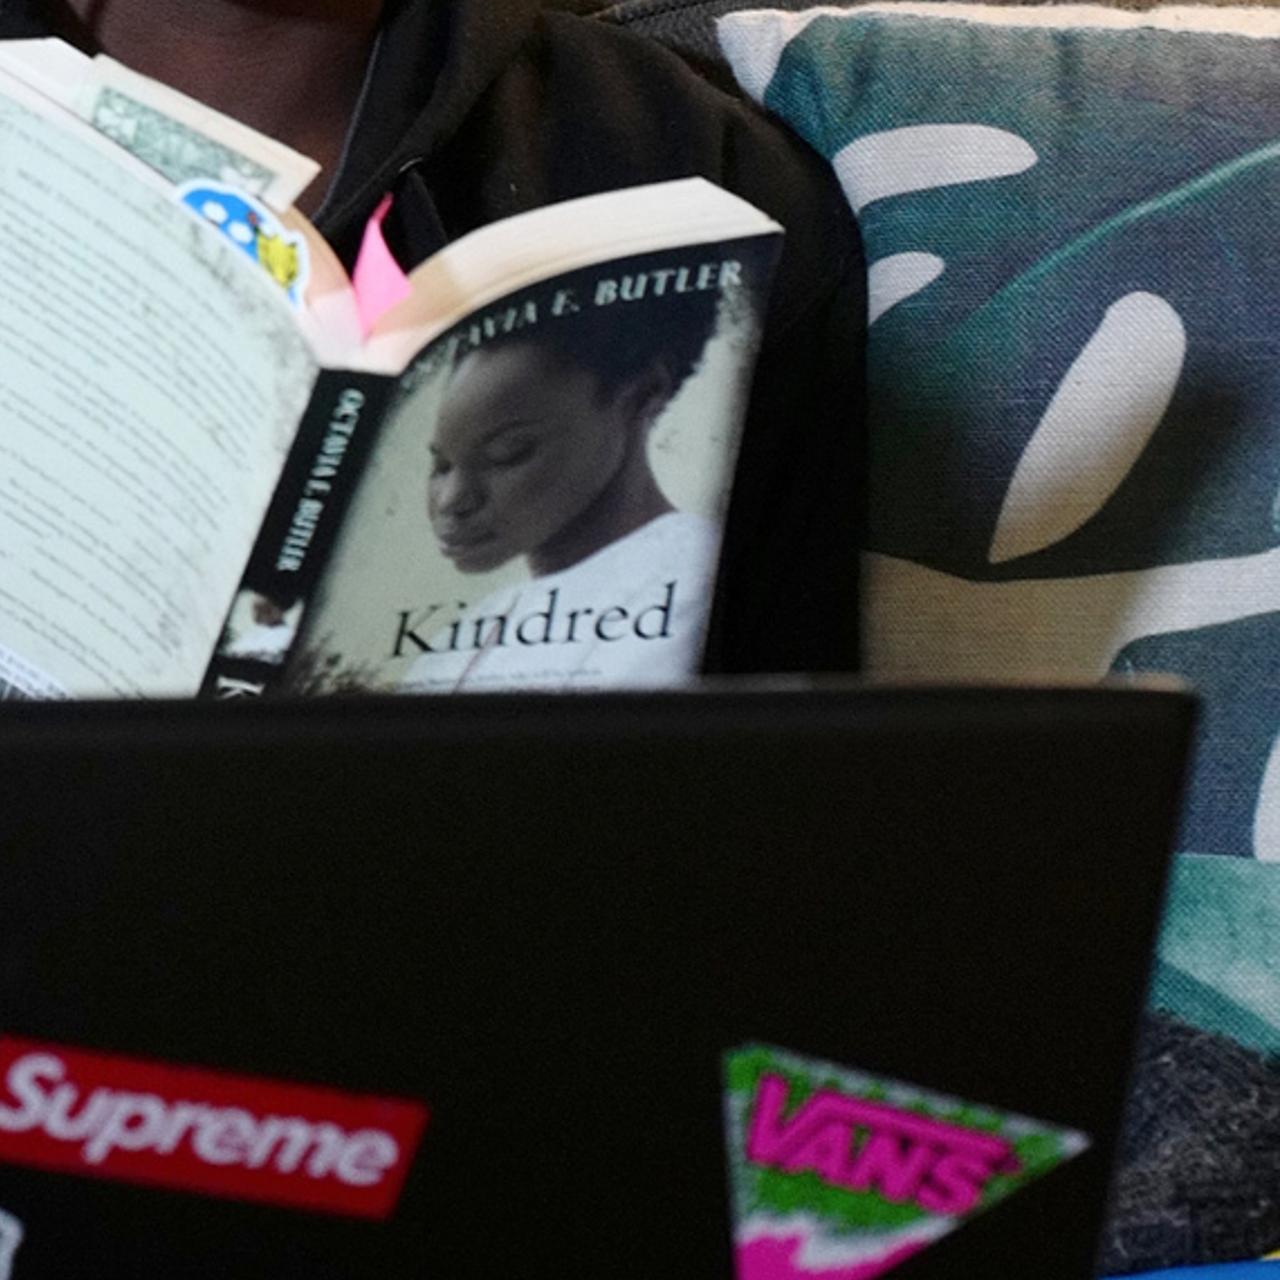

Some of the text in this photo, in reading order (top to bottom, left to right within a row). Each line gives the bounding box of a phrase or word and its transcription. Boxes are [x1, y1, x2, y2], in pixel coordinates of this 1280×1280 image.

[594, 260, 743, 307] BUTLER
[311, 387, 366, 478] OCTAVIA
[276, 497, 325, 572] BUTLER
[391, 580, 680, 660] Kindred
[746, 1071, 1025, 1216] VANS
